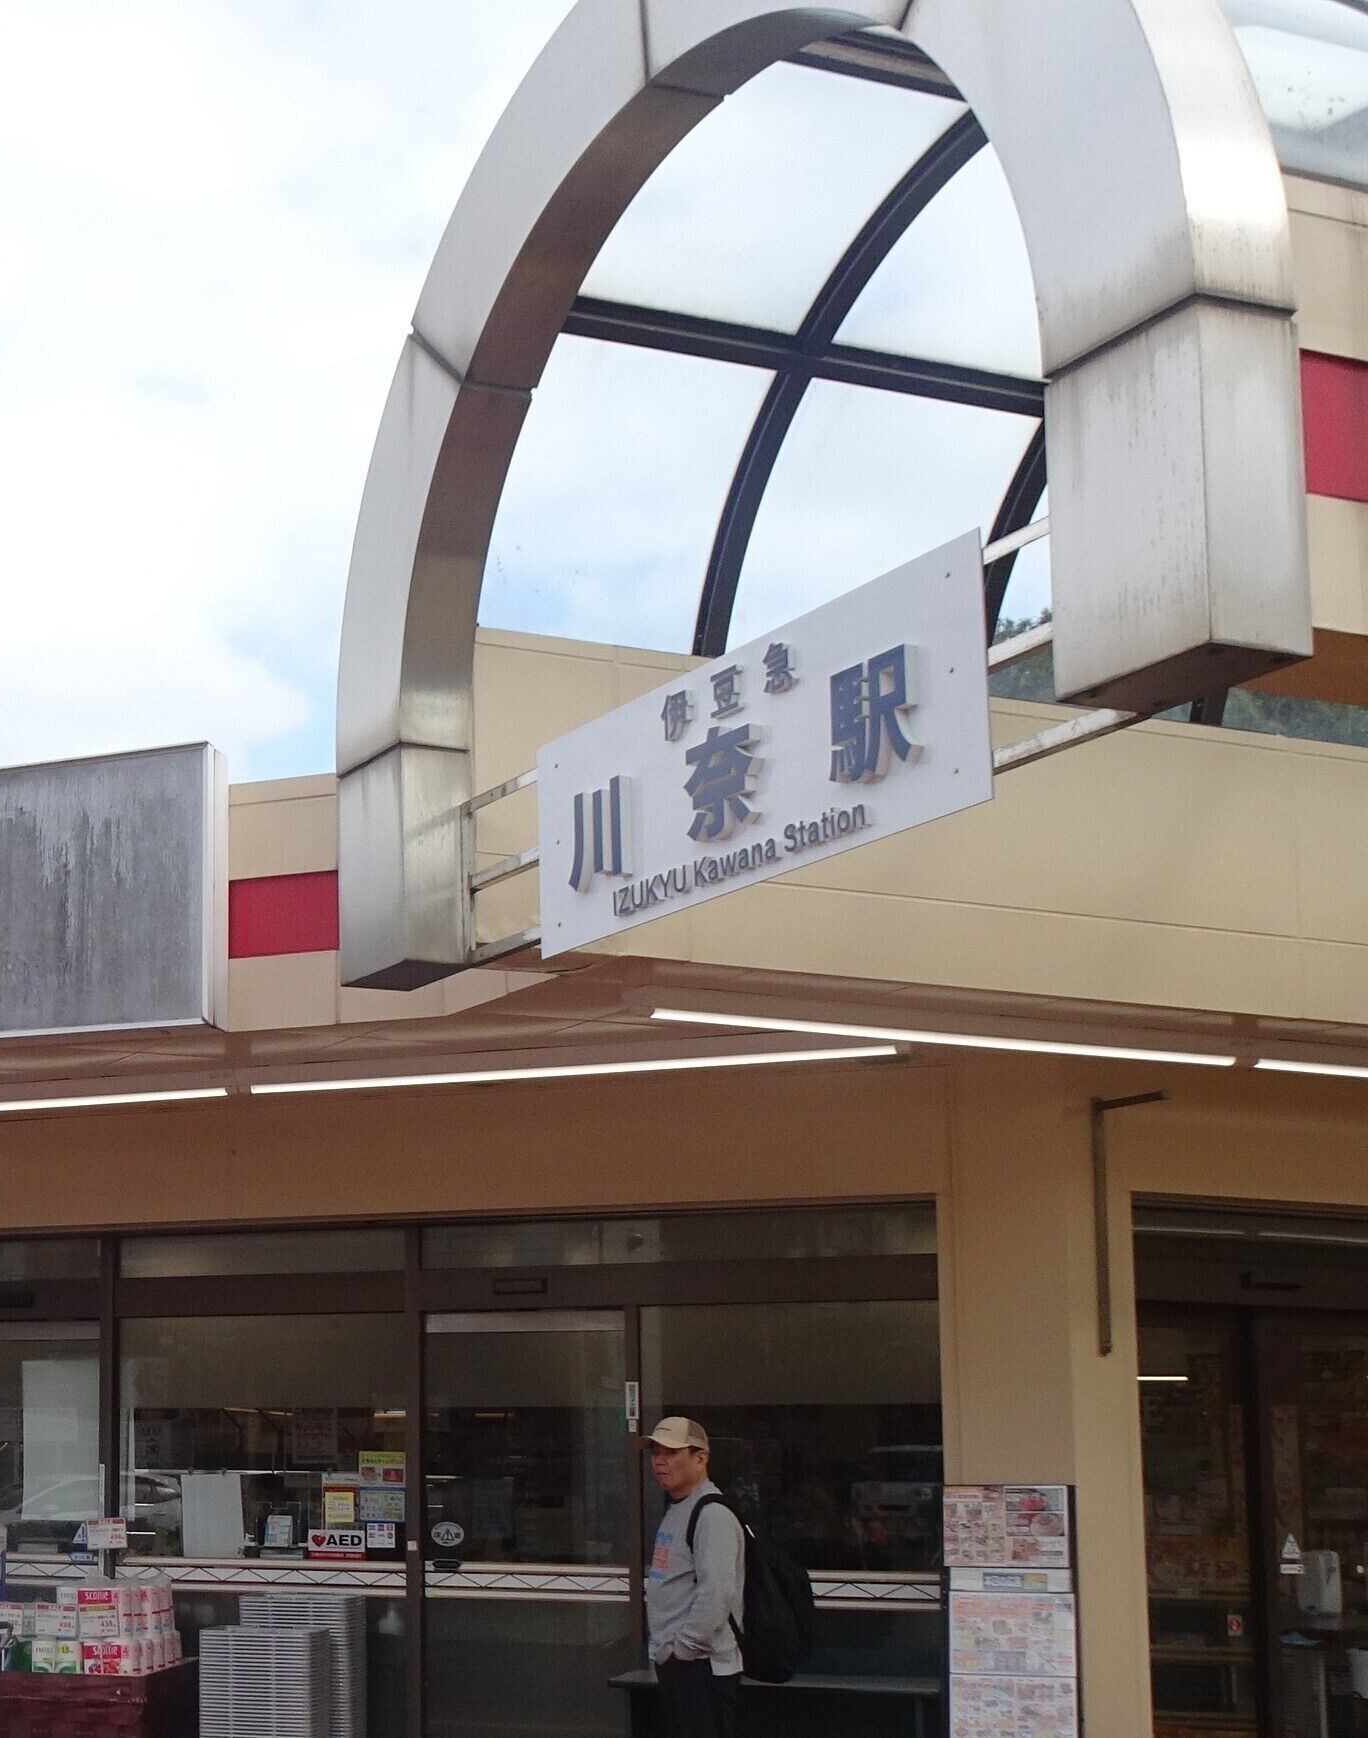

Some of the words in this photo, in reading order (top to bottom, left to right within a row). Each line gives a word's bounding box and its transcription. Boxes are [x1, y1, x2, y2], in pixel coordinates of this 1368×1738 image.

[661, 641, 799, 742] 伊豆急
[568, 643, 924, 894] 川奈駅
[612, 864, 692, 918] IZUKYU
[692, 837, 783, 888] Kawana
[783, 802, 871, 854] Station
[326, 1534, 362, 1547] AED
